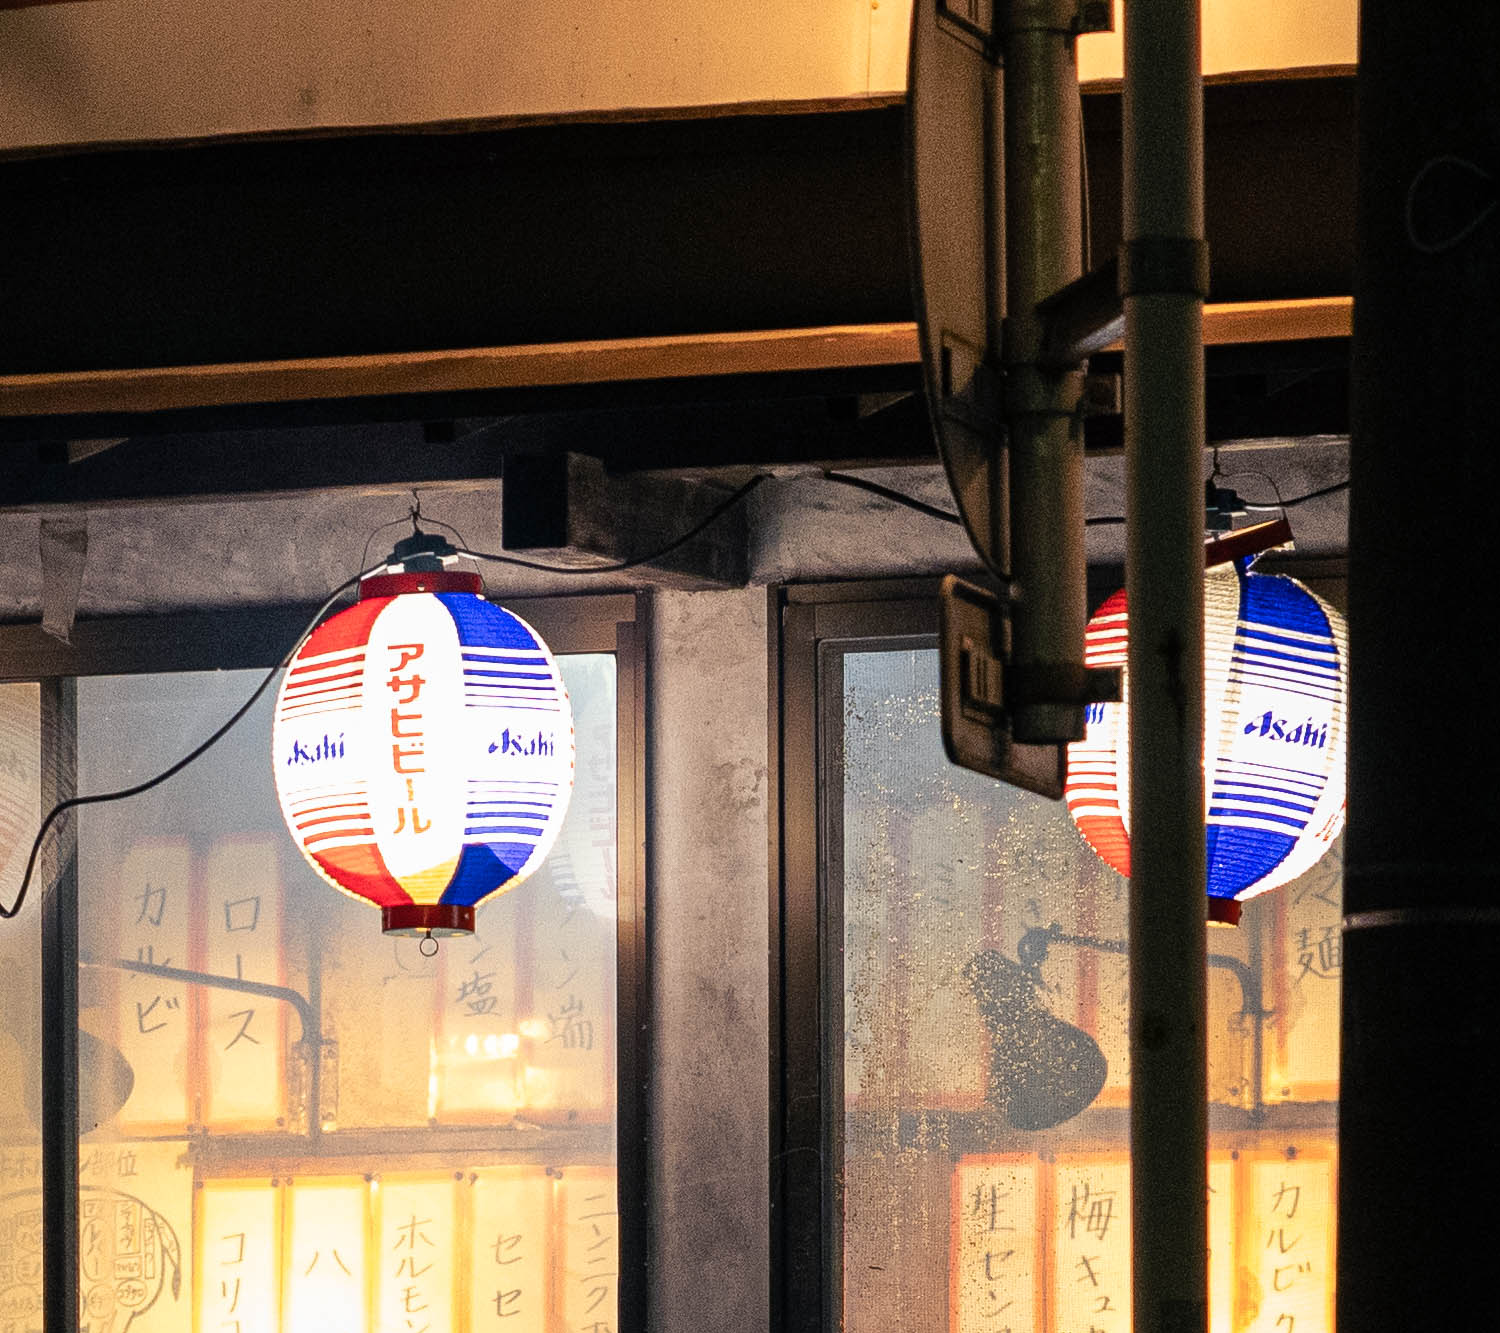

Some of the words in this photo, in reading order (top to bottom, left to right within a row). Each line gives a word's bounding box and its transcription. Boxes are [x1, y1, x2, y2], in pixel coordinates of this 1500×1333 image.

[287, 732, 345, 766] Asahi
[386, 643, 431, 834] アサヒビール
[488, 728, 553, 757] Asahi
[1244, 710, 1328, 749] Asahi
[223, 895, 261, 1051] ロース
[455, 930, 500, 1018] ン塩
